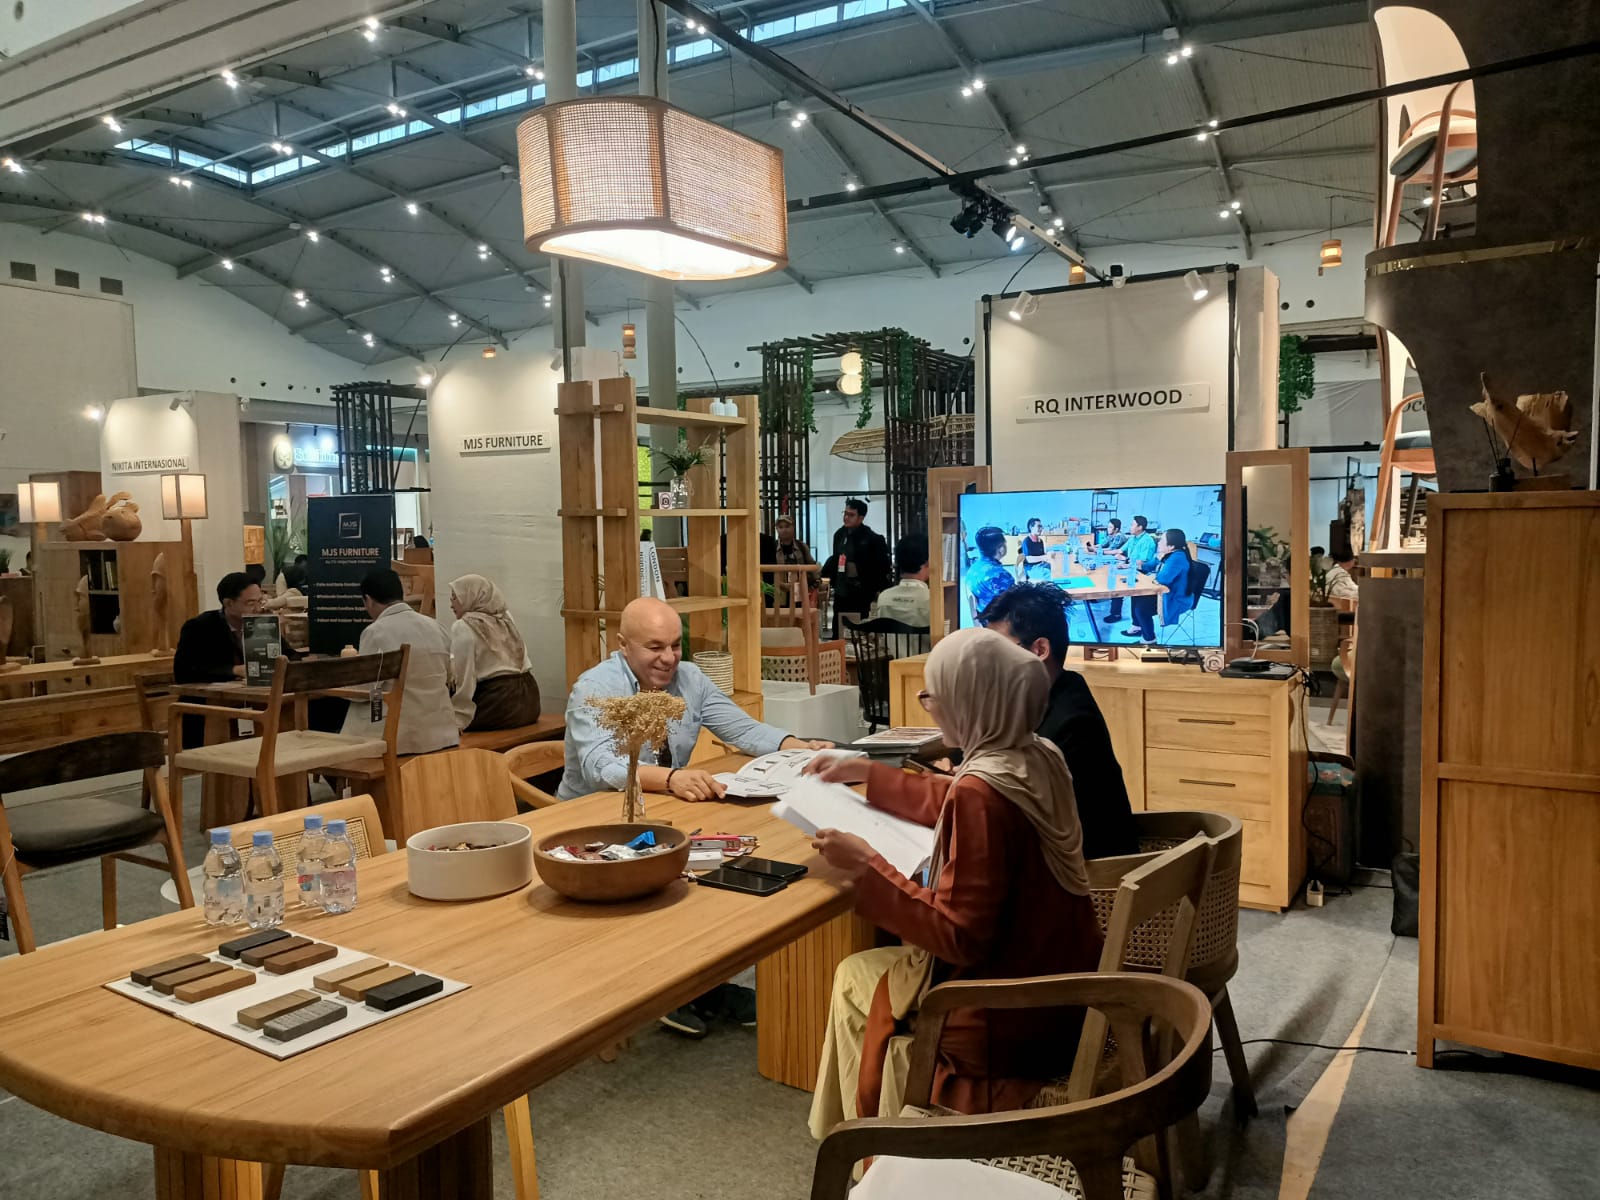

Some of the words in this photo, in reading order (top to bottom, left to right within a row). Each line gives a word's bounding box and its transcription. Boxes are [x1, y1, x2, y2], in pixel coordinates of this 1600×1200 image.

[1034, 398, 1060, 414] RQ
[1065, 389, 1183, 412] INTERWOOD
[463, 438, 483, 450] MJS
[486, 434, 543, 449] FURNITURE
[111, 461, 133, 471] NIKITA
[133, 458, 187, 470] INTERNASIONAL
[321, 548, 338, 557] MJS
[339, 547, 380, 556] FURNITURE
[650, 546, 661, 583] LONDON
